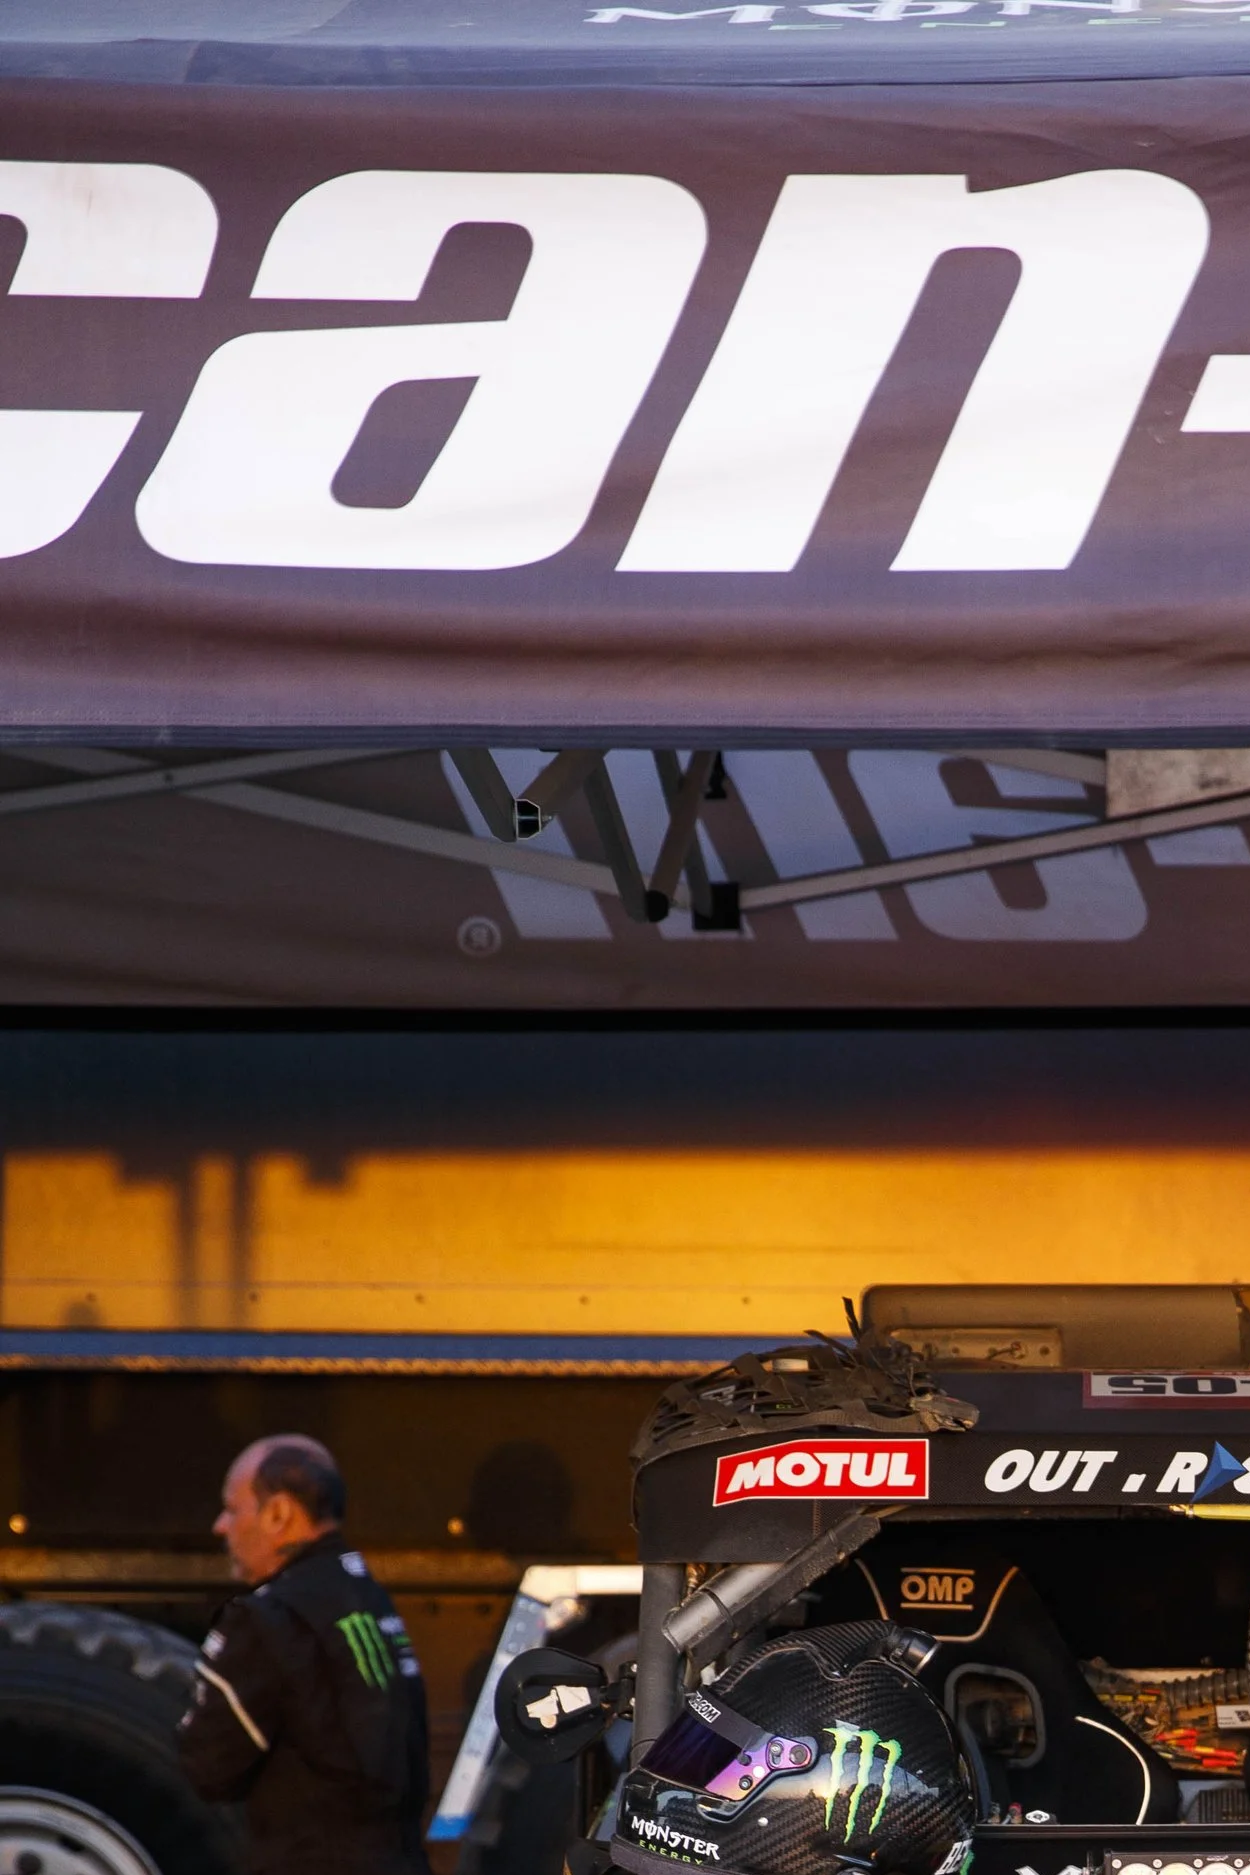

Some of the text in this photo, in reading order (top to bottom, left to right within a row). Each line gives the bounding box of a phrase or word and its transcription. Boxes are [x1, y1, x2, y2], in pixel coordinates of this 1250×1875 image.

[725, 1452, 916, 1494] MOTUL
[901, 1575, 974, 1602] OMP
[631, 1815, 720, 1860] MONSTER
[639, 1839, 703, 1866] ENERGY
